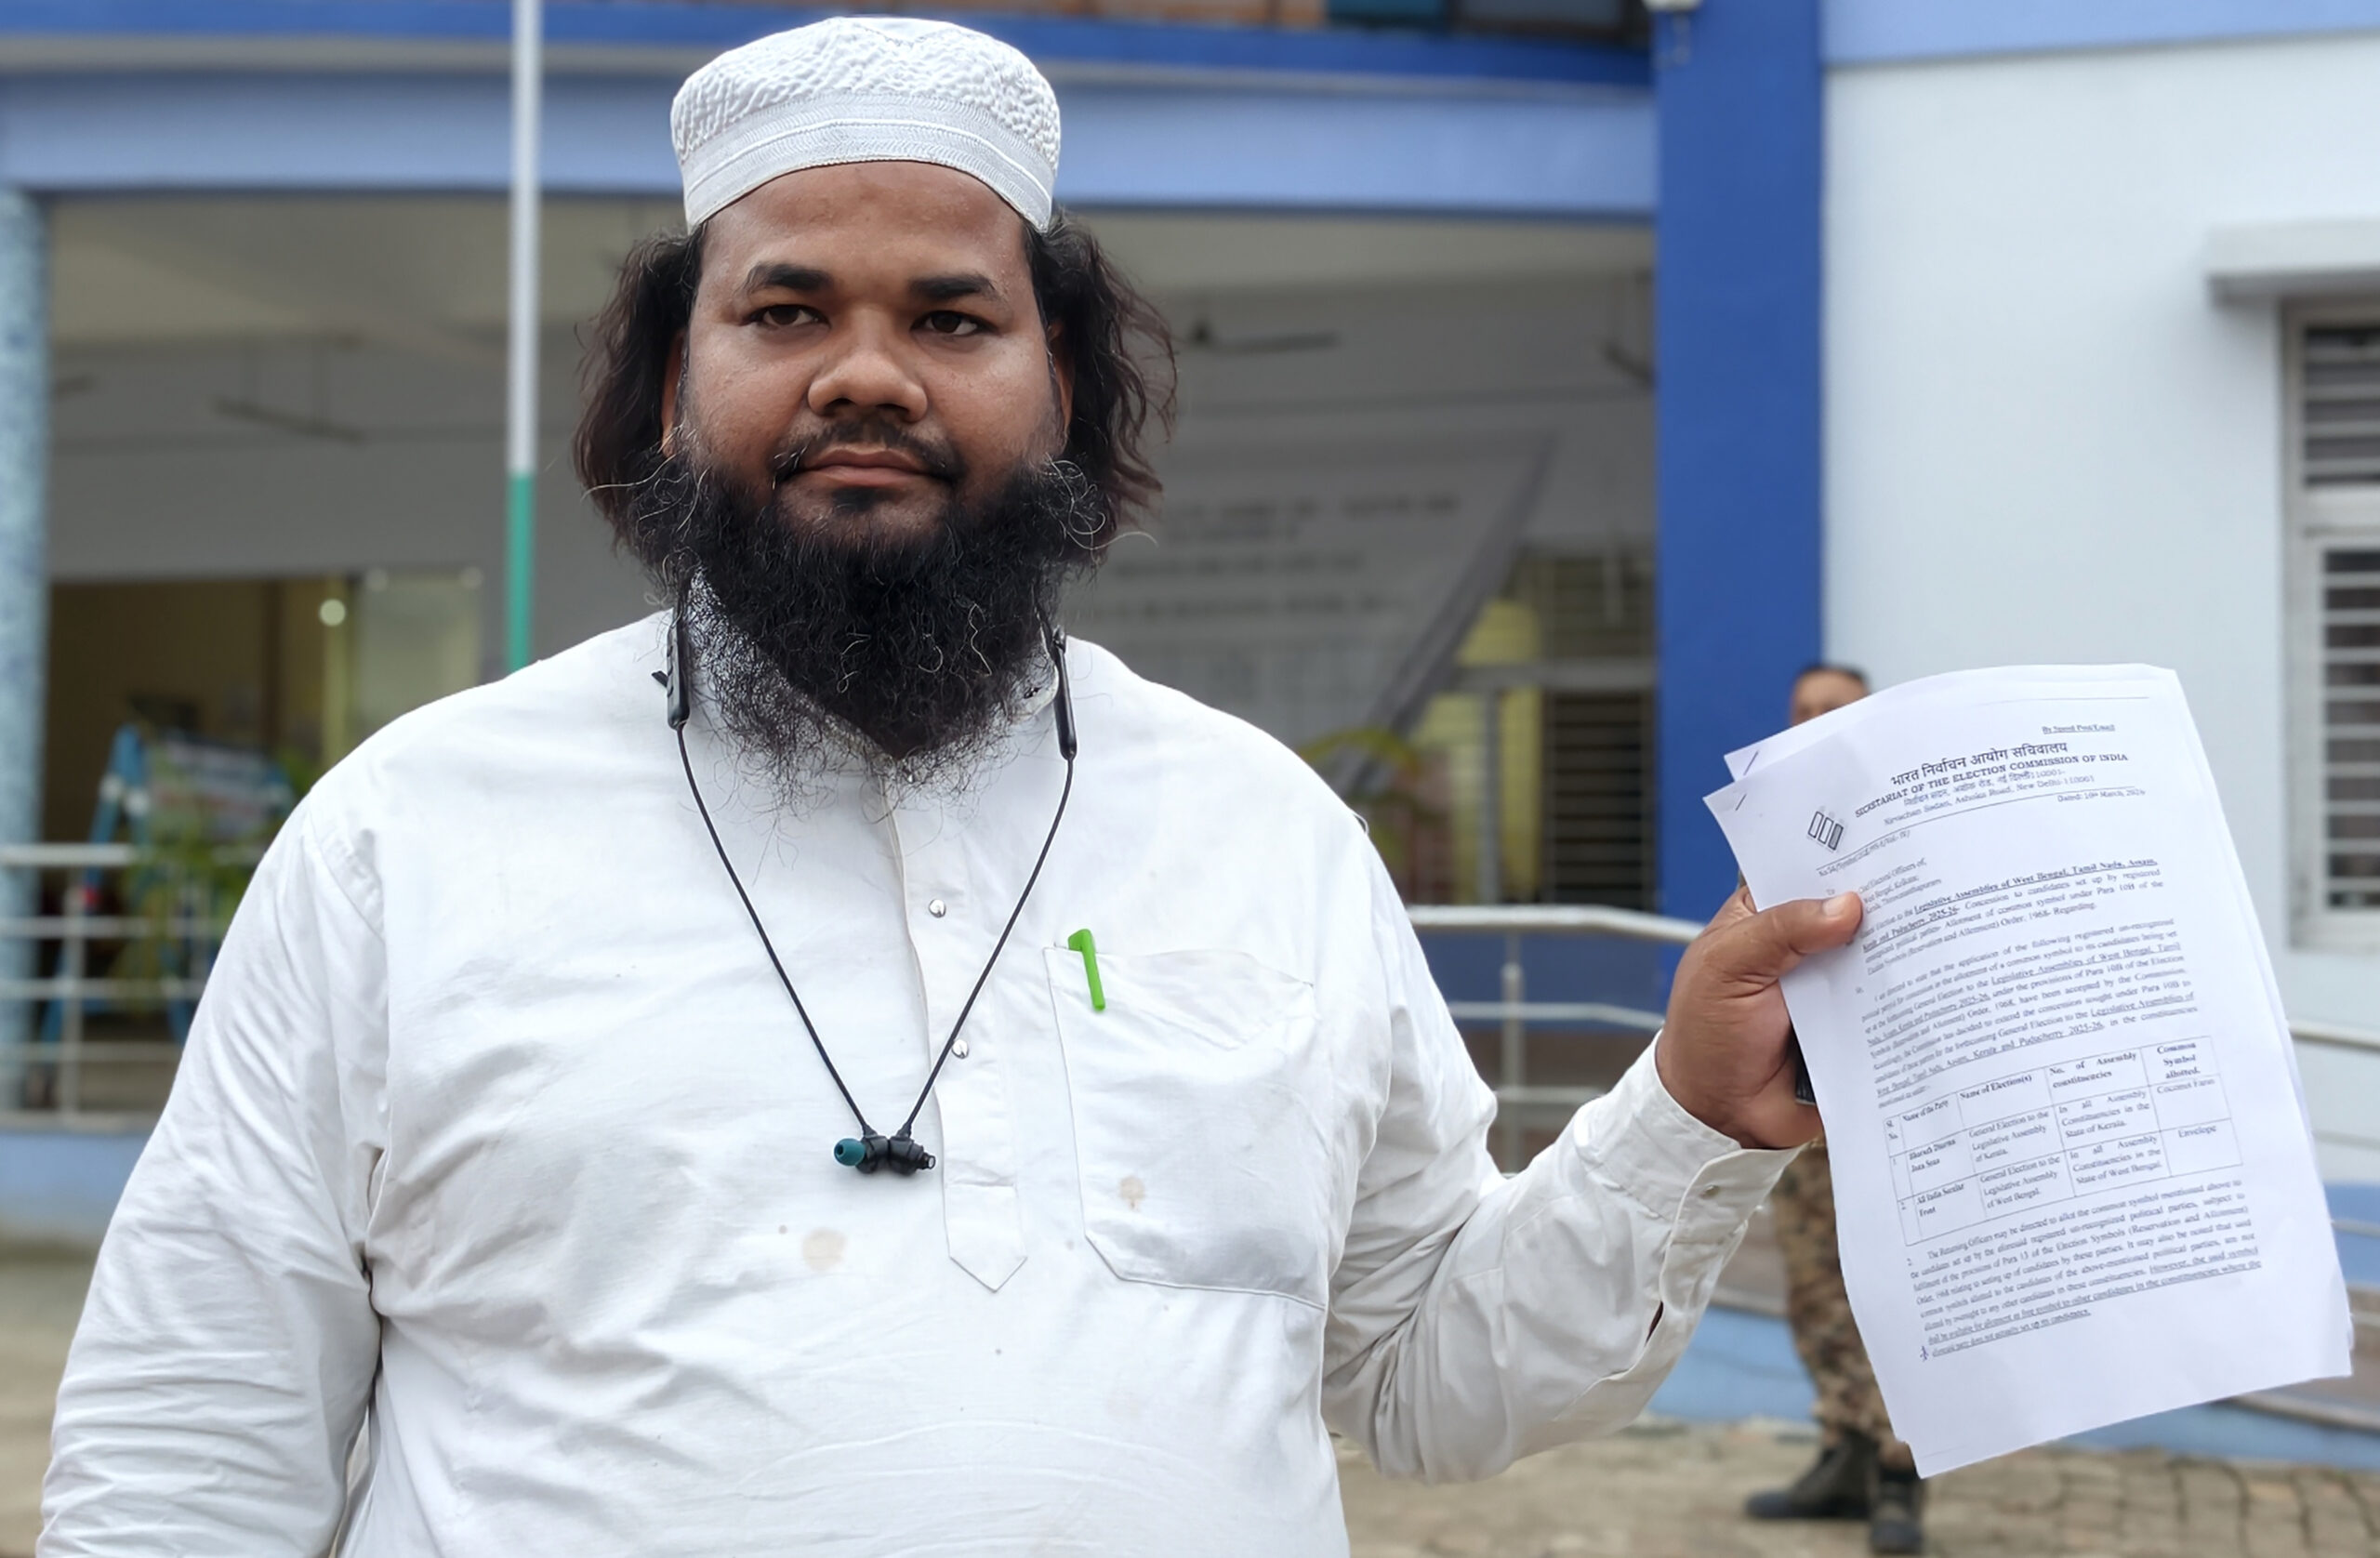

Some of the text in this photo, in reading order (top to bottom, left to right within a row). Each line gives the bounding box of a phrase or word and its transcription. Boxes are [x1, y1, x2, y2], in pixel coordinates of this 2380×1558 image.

[1891, 743, 2068, 786] भारत निर्वाचन आयोग सचिवालय
[1855, 788, 1908, 817] SECRETARIAT
[1911, 784, 1924, 794] OF
[1928, 777, 1950, 788] THE
[1952, 764, 2006, 783] ELECTION
[2010, 755, 2079, 771] COMMISSION
[2099, 754, 2128, 762] INDIA
[2013, 876, 2033, 885] West
[2157, 1042, 2196, 1054] Common
[2076, 1061, 2084, 1070] of
[2096, 1052, 2136, 1065] Assembly
[2163, 1054, 2196, 1066] Symbol
[1960, 1089, 1980, 1099] Name
[1982, 1085, 1989, 1093] of
[2137, 1102, 2149, 1111] the
[2086, 1124, 2096, 1133] of
[2148, 1148, 2161, 1156] the
[2048, 1156, 2060, 1165] the
[2097, 1170, 2107, 1179] of
